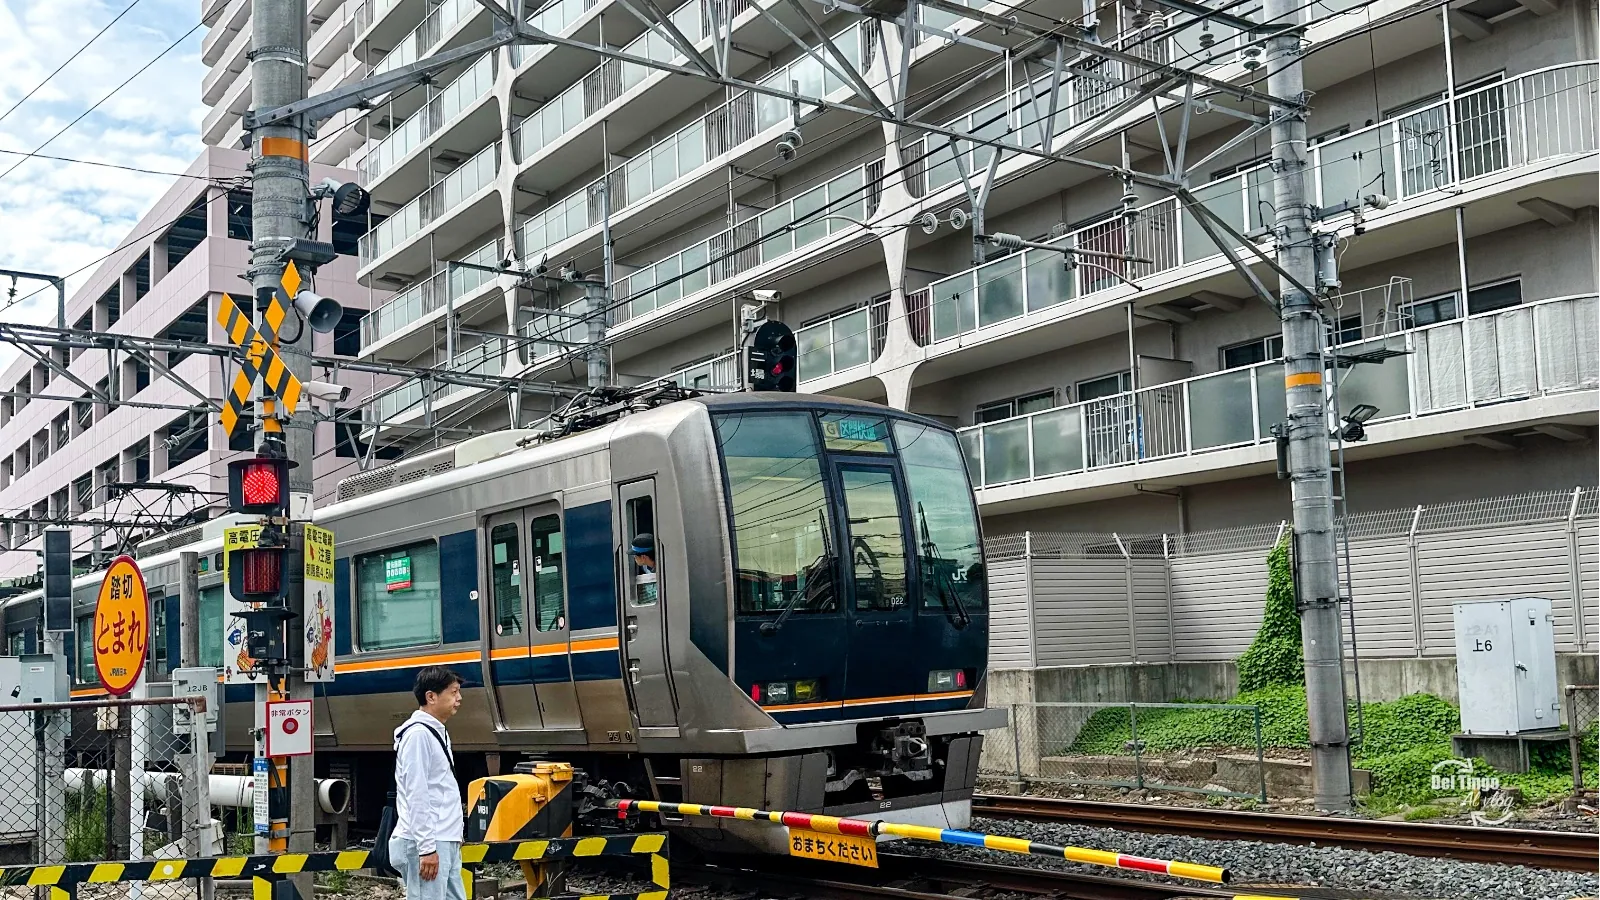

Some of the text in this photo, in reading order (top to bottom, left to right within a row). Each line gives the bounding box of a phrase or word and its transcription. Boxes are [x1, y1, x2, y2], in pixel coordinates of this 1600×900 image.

[827, 423, 836, 435] G
[299, 496, 308, 514] 7
[228, 529, 260, 545] 高電圧
[318, 546, 332, 565] 注意
[952, 568, 968, 581] JR
[110, 574, 133, 600] 踏切
[890, 596, 904, 605] 022
[97, 610, 144, 655] とまれ
[1472, 638, 1493, 652] 上6
[271, 708, 310, 718] 非常ボタン
[692, 765, 703, 773] 22
[792, 835, 873, 861] おまちください
